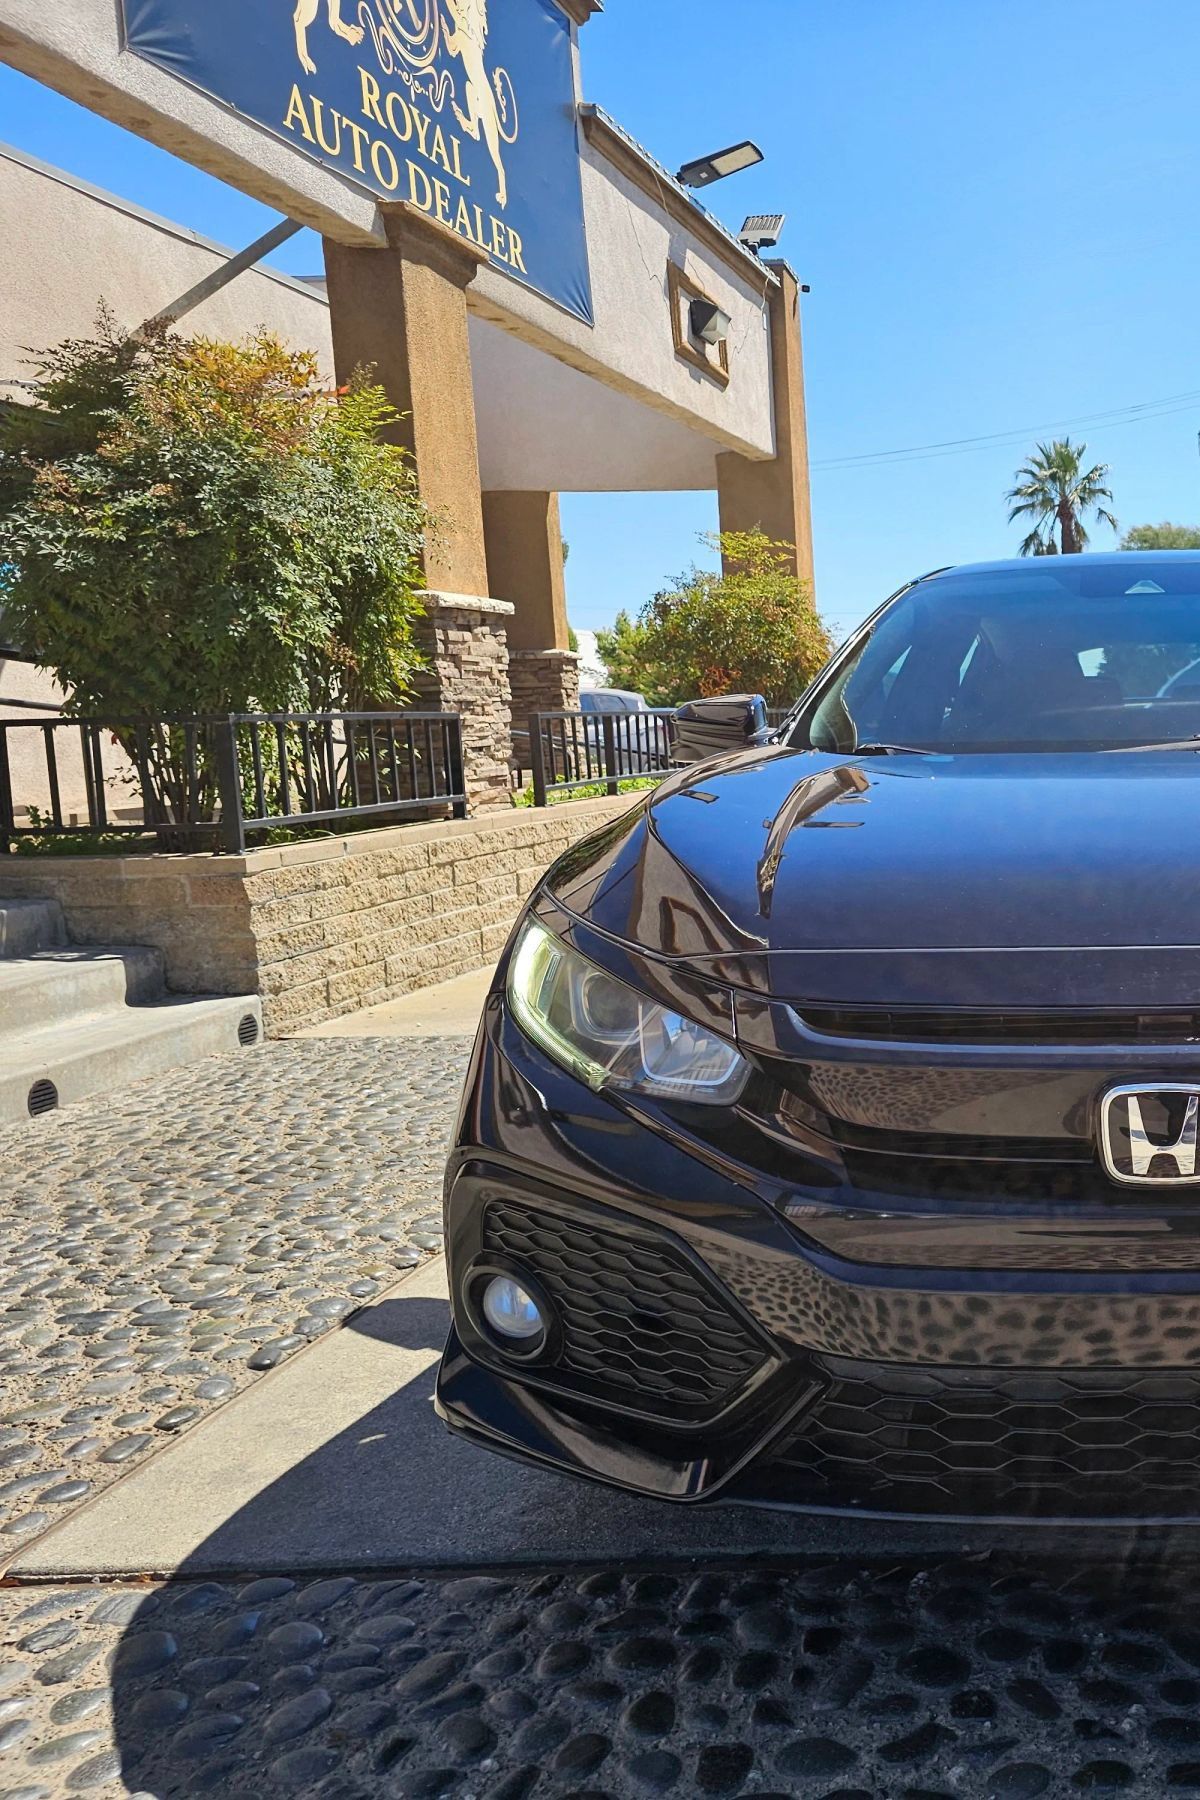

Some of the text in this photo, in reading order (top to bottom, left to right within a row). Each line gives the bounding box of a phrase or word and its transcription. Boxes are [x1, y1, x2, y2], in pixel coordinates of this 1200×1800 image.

[283, 83, 528, 275] AUTO DEALER
[357, 65, 471, 187] ROYAL
